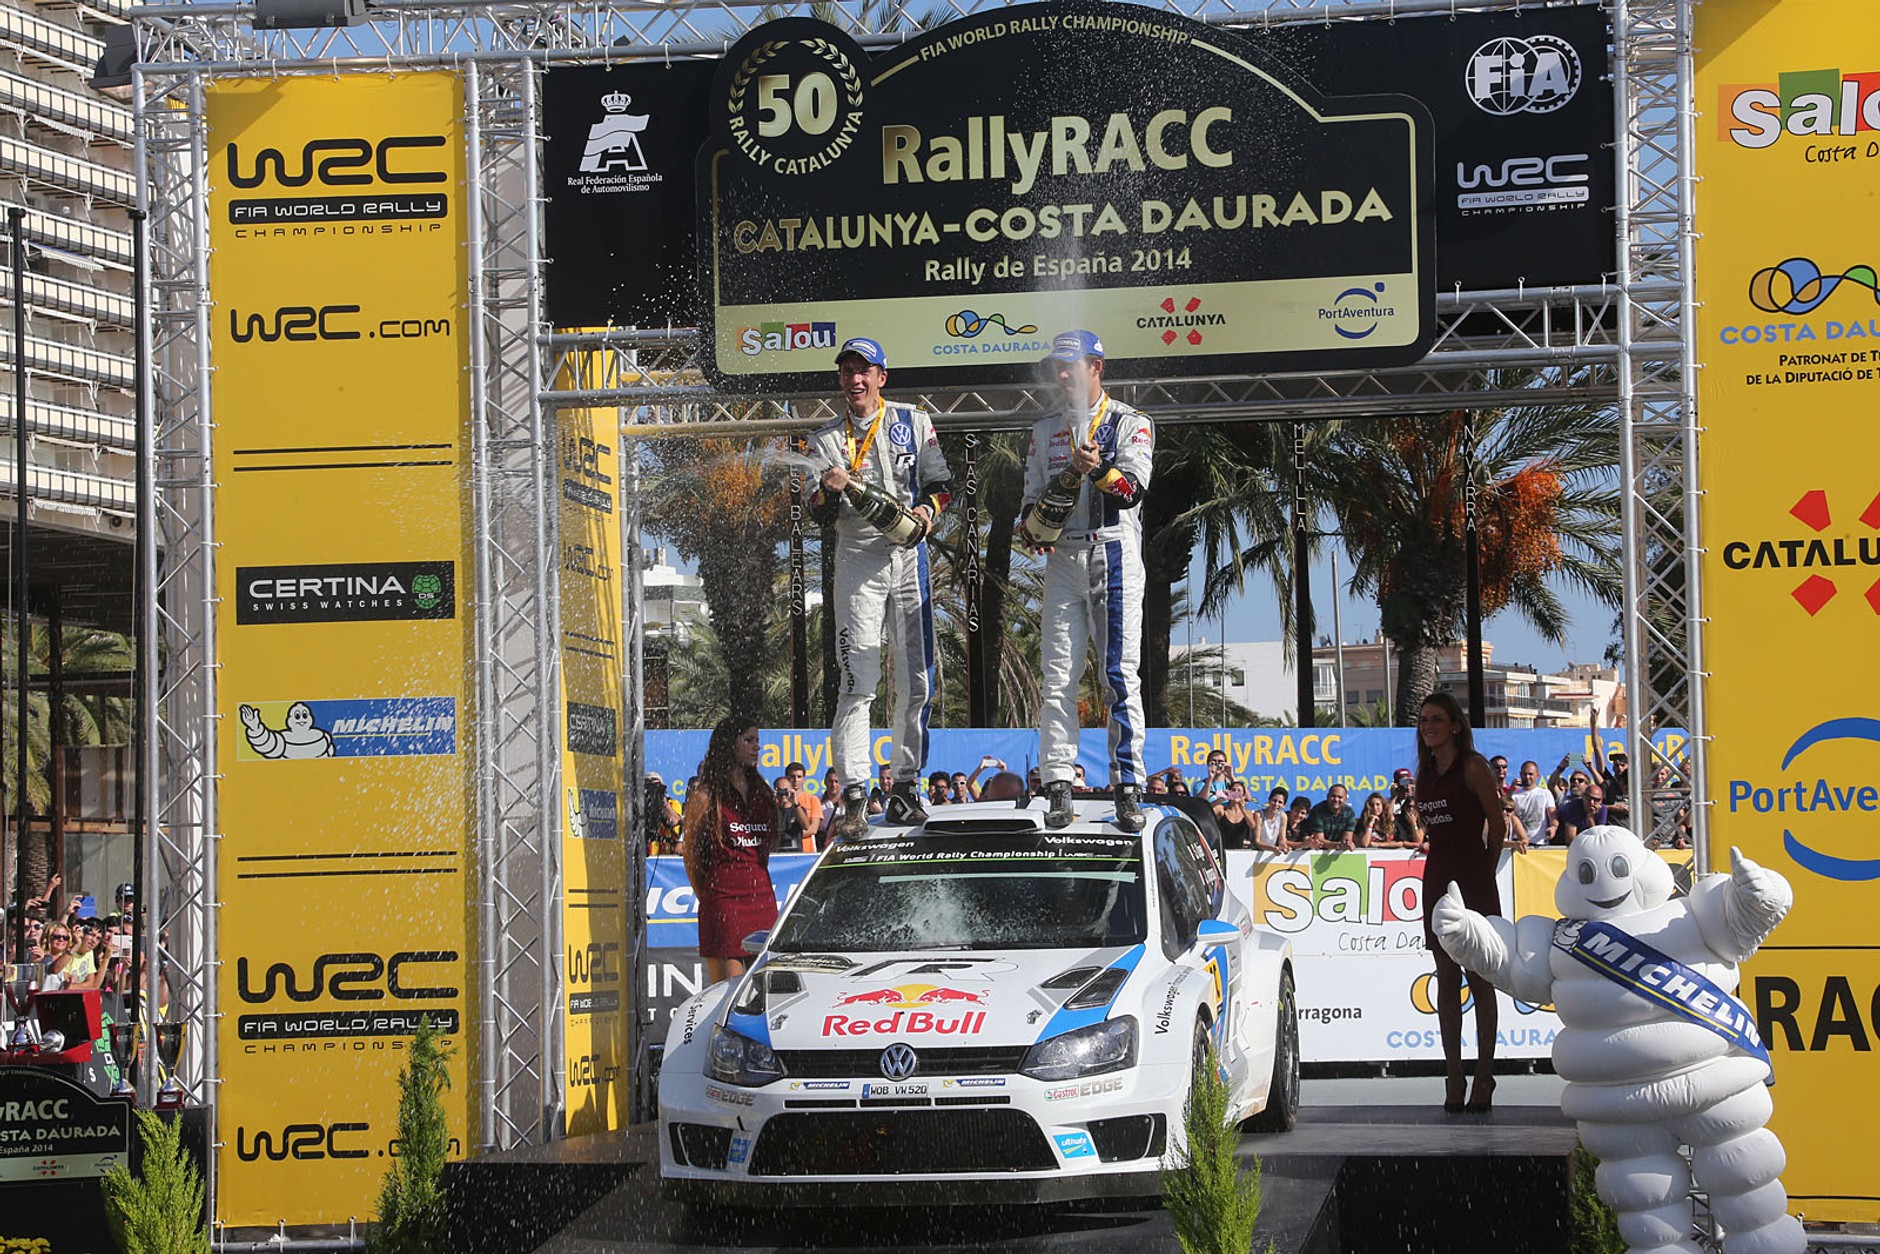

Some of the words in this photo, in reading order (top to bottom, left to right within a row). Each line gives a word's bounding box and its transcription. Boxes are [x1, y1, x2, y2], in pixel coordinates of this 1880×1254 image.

[920, 41, 947, 61] FIA
[949, 23, 1006, 50] WORLD
[1010, 16, 1059, 34] RALLY
[1062, 15, 1189, 45] CHAMPIONSHIP
[758, 71, 838, 137] 50
[729, 116, 772, 166] RALLY
[774, 111, 864, 175] CATALUNYA
[882, 106, 1233, 195] RallyRACC
[227, 136, 448, 188] WRC
[1805, 144, 1857, 163] Costa
[568, 177, 584, 186] Real
[586, 174, 627, 186] Federación
[629, 172, 663, 185] Española
[1457, 154, 1589, 188] WRC
[580, 186, 591, 194] de
[592, 183, 650, 194] Automovilismo
[1486, 194, 1534, 203] WORLD
[1538, 190, 1585, 199] RALLY
[235, 206, 268, 218] FIA
[275, 202, 355, 217] WORLD
[363, 199, 442, 214] RALLY
[1142, 187, 1393, 234] DAURADA
[1462, 203, 1585, 216] CHAMPIONSHIP
[235, 223, 442, 239] CHAMPIONSHIP
[925, 259, 985, 285] Rally
[994, 255, 1024, 279] de
[1033, 251, 1122, 281] España
[1131, 247, 1192, 273] 2014
[1136, 313, 1226, 328] CATALUNYA
[1318, 306, 1395, 320] PortAventura
[741, 324, 831, 356] Salou
[1719, 323, 1817, 345] COSTA
[932, 344, 978, 356] COSTA
[981, 340, 1050, 354] DAURADA
[1779, 353, 1848, 367] PATRONAT
[1785, 367, 1853, 384] DIPUTACIÓ
[1294, 424, 1306, 532] MELILLA
[1464, 425, 1476, 532] NAVARRA
[790, 505, 803, 615] BALEARS
[1723, 537, 1880, 570] CATALU
[966, 507, 979, 632] CANARIAS
[249, 576, 406, 599] CERTINA
[253, 602, 309, 612] SWISS
[320, 599, 403, 611] WATCHES
[332, 714, 454, 735] MICHELIN
[1296, 775, 1395, 792] DAURAD
[1730, 779, 1879, 813] PortAve
[729, 822, 768, 834] Segura
[836, 841, 915, 853] Volkswagen
[1044, 836, 1134, 847] Volkswagen
[876, 854, 895, 862] FIA
[899, 853, 934, 861] World
[936, 851, 967, 861] Rally
[970, 850, 1056, 859] Championship
[1264, 866, 1425, 934] Salo
[1338, 932, 1387, 951] Costa
[569, 942, 620, 985] WRC
[237, 950, 459, 1004] WRC
[1583, 931, 1763, 1049] MICHELIN
[683, 1002, 703, 1045] Services
[1755, 976, 1880, 1052] RA
[244, 1021, 278, 1033] FIA
[284, 1018, 367, 1032] WORLD
[822, 1012, 900, 1037] Red
[906, 1011, 987, 1035] Bull
[244, 1039, 454, 1055] CHAMPIONSP
[807, 1081, 850, 1089] MICHELIN
[870, 1086, 889, 1095] WOB
[961, 1079, 1005, 1087] MICHELIN
[1080, 1077, 1124, 1097] EDGE
[1053, 1087, 1077, 1099] Castrol
[0, 1099, 69, 1121] RACC
[36, 1125, 121, 1140] DAURADA
[32, 1143, 54, 1152] 2014
